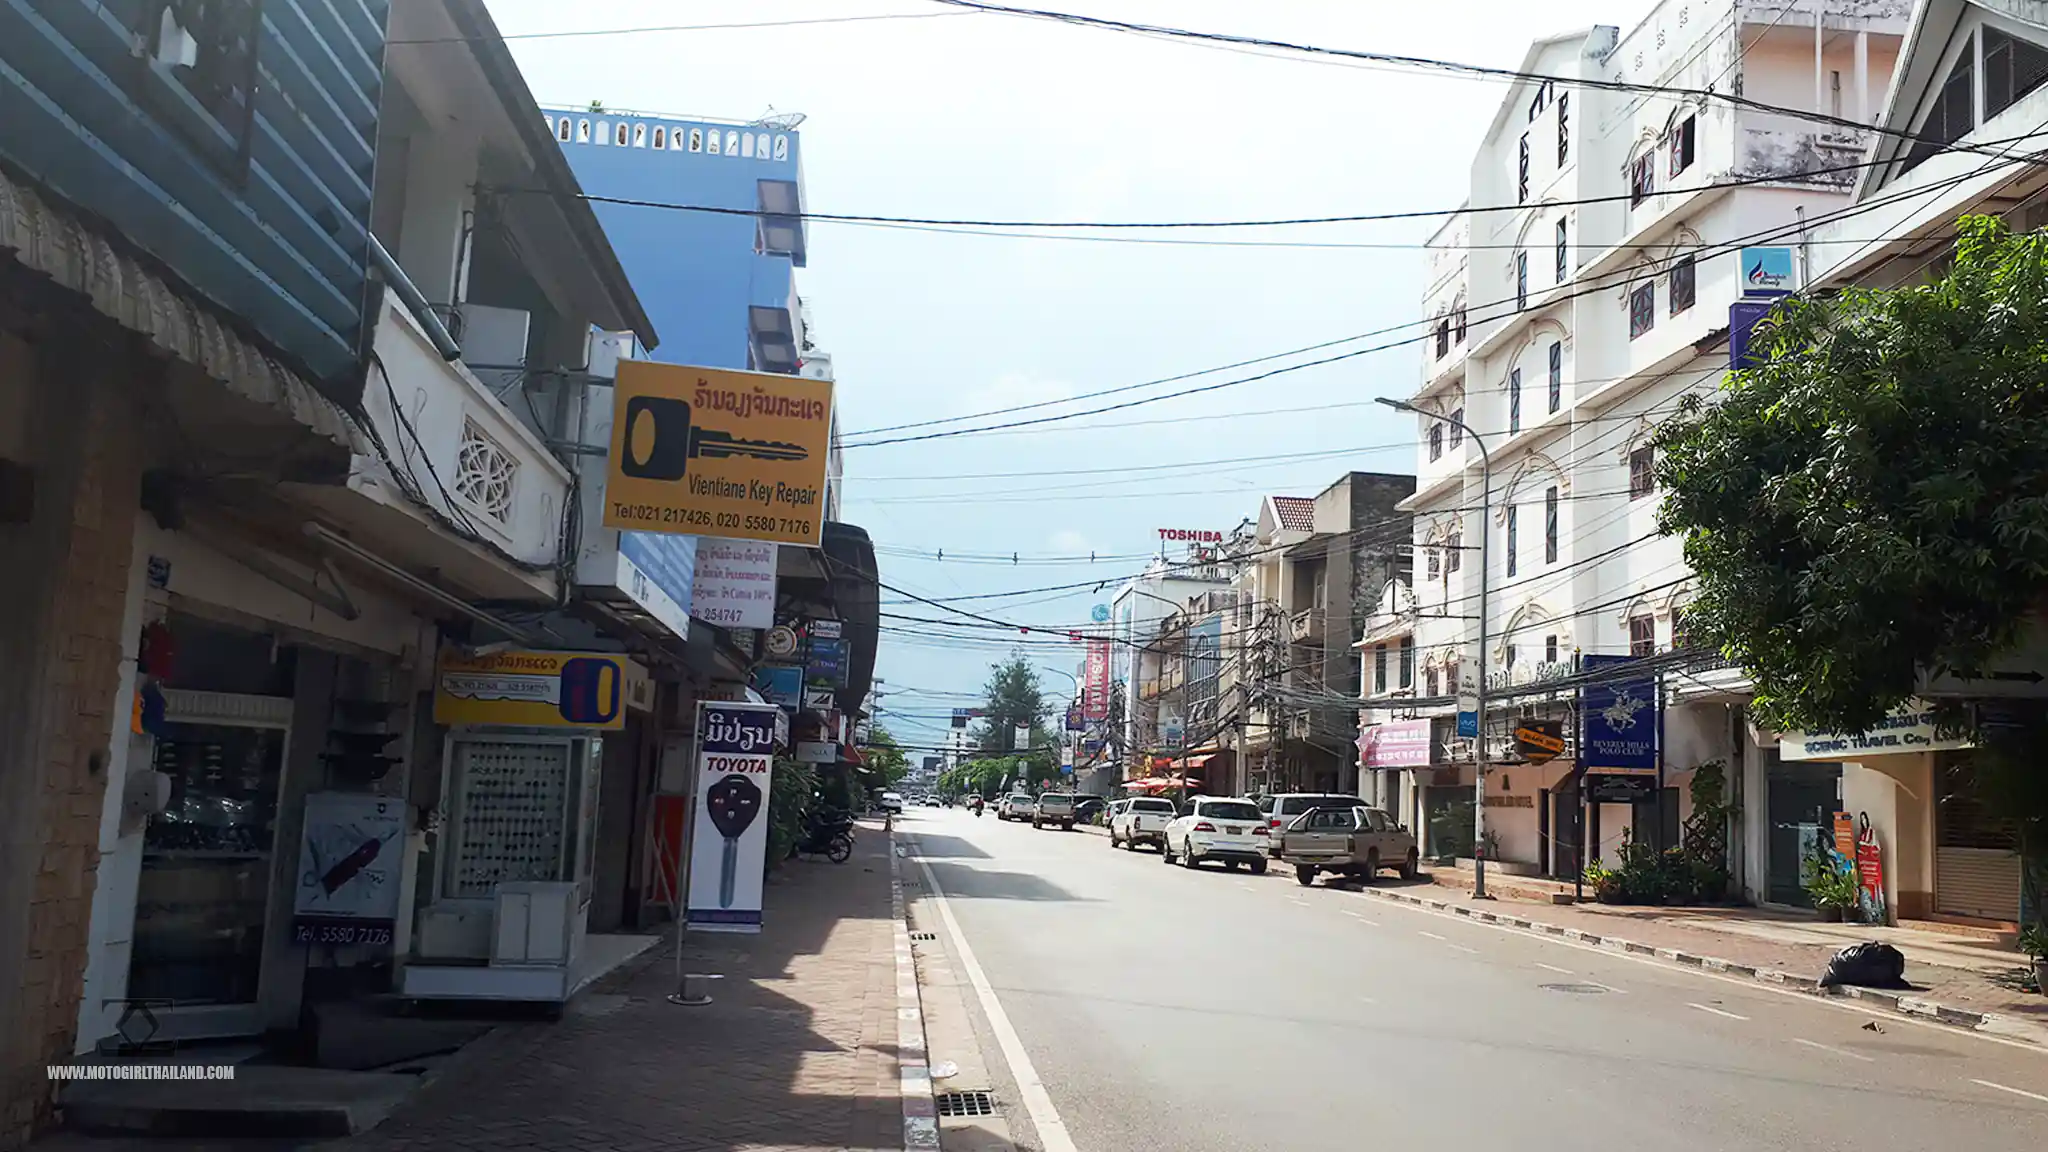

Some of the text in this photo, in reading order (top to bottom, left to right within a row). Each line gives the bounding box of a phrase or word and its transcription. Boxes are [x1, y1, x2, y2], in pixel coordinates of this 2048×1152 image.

[689, 473, 817, 508] Vientiane Key Repair
[614, 502, 810, 535] Tel:021 217426, 020 5580 7176
[1158, 528, 1223, 543] TOSHIBA
[704, 607, 743, 622] 254747
[1593, 740, 1650, 750] BEVERLY HILLS
[1599, 747, 1645, 756] POLO CLUB
[1804, 738, 1848, 752] SCENIC
[1850, 734, 1901, 749] TRAVEL
[707, 757, 767, 774] TOYOTA
[295, 925, 391, 944] Tel. 5580 7176
